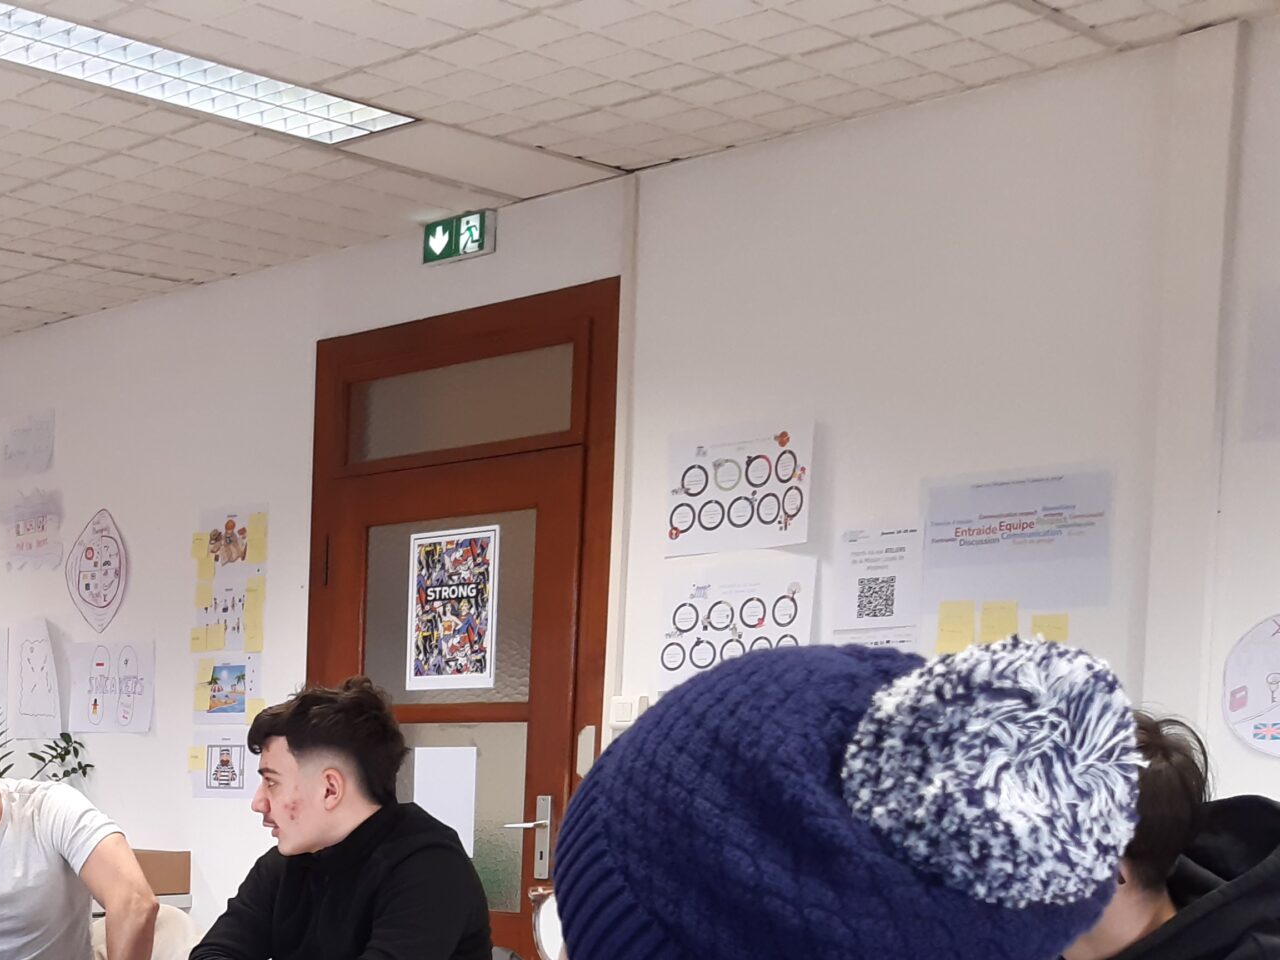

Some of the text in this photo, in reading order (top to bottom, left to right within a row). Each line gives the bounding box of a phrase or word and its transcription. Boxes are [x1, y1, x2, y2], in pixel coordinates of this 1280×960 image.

[954, 525, 998, 538] Entraide
[998, 520, 1036, 533] Equipe
[959, 536, 1000, 547] Discussion
[426, 584, 477, 600] STRONG
